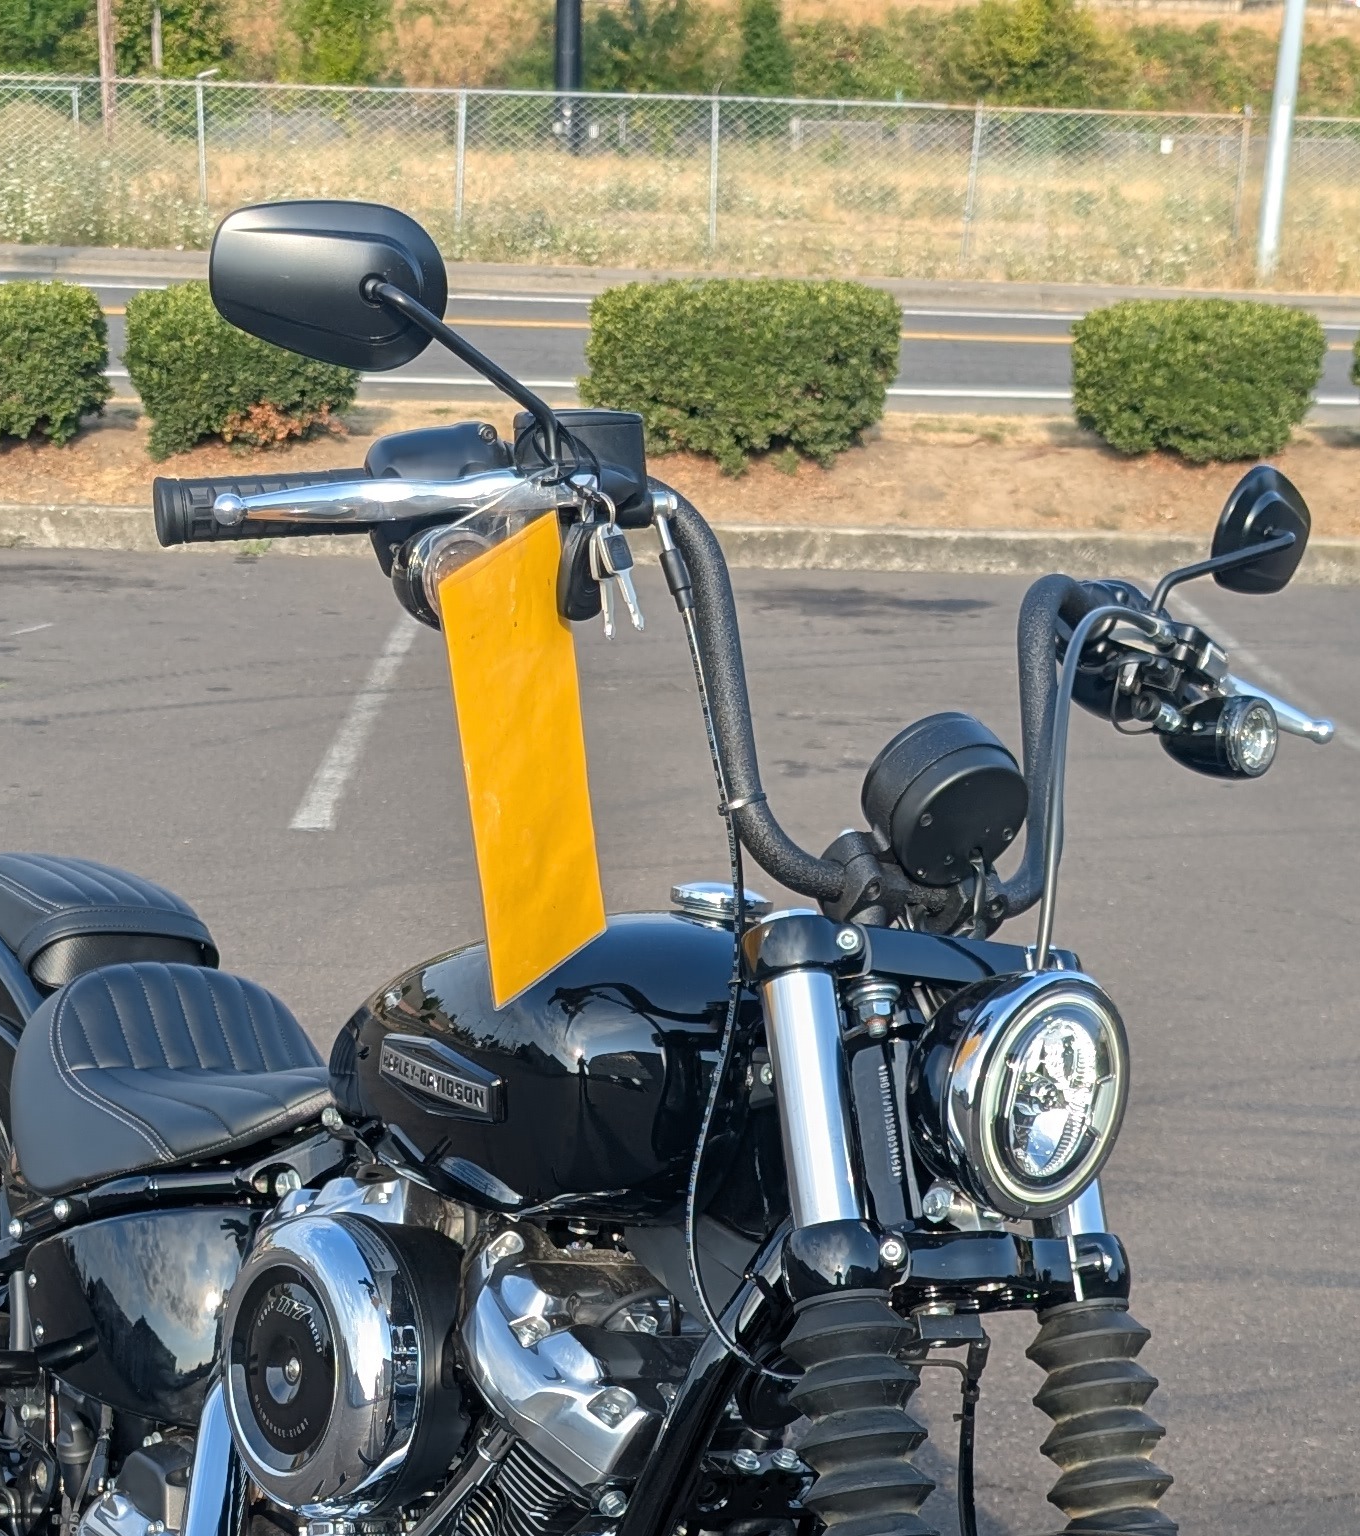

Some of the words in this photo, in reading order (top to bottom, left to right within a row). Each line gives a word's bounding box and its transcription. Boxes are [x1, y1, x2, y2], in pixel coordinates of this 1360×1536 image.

[382, 1051, 486, 1108] HARLEY-DAVIDSON
[257, 1301, 275, 1327] CUBIC
[276, 1295, 314, 1321] 117
[307, 1317, 323, 1353] INCHES
